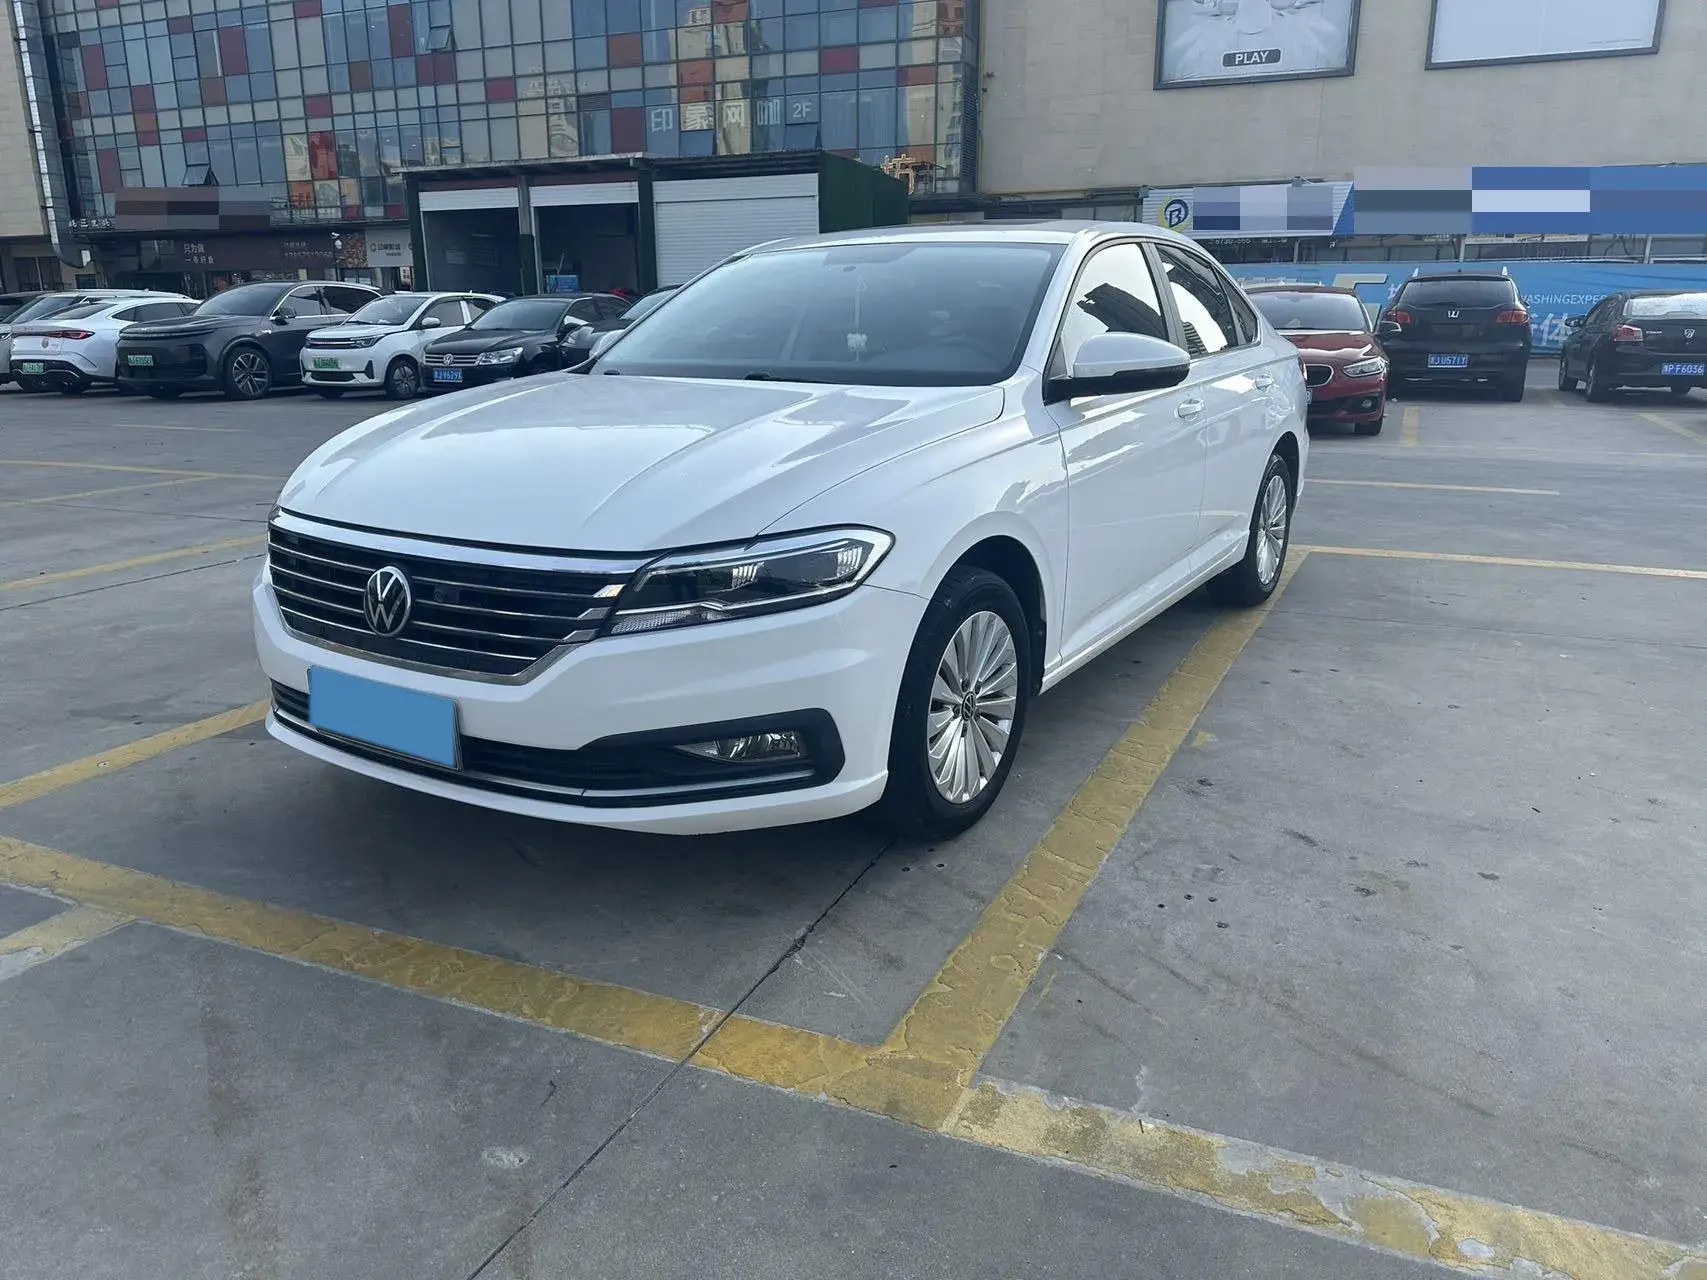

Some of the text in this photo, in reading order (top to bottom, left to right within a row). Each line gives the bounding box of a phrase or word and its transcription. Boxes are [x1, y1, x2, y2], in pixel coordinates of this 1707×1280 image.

[1235, 51, 1269, 65] PLAY
[792, 102, 813, 118] 2F
[1521, 294, 1607, 305] ASHINGEXPE
